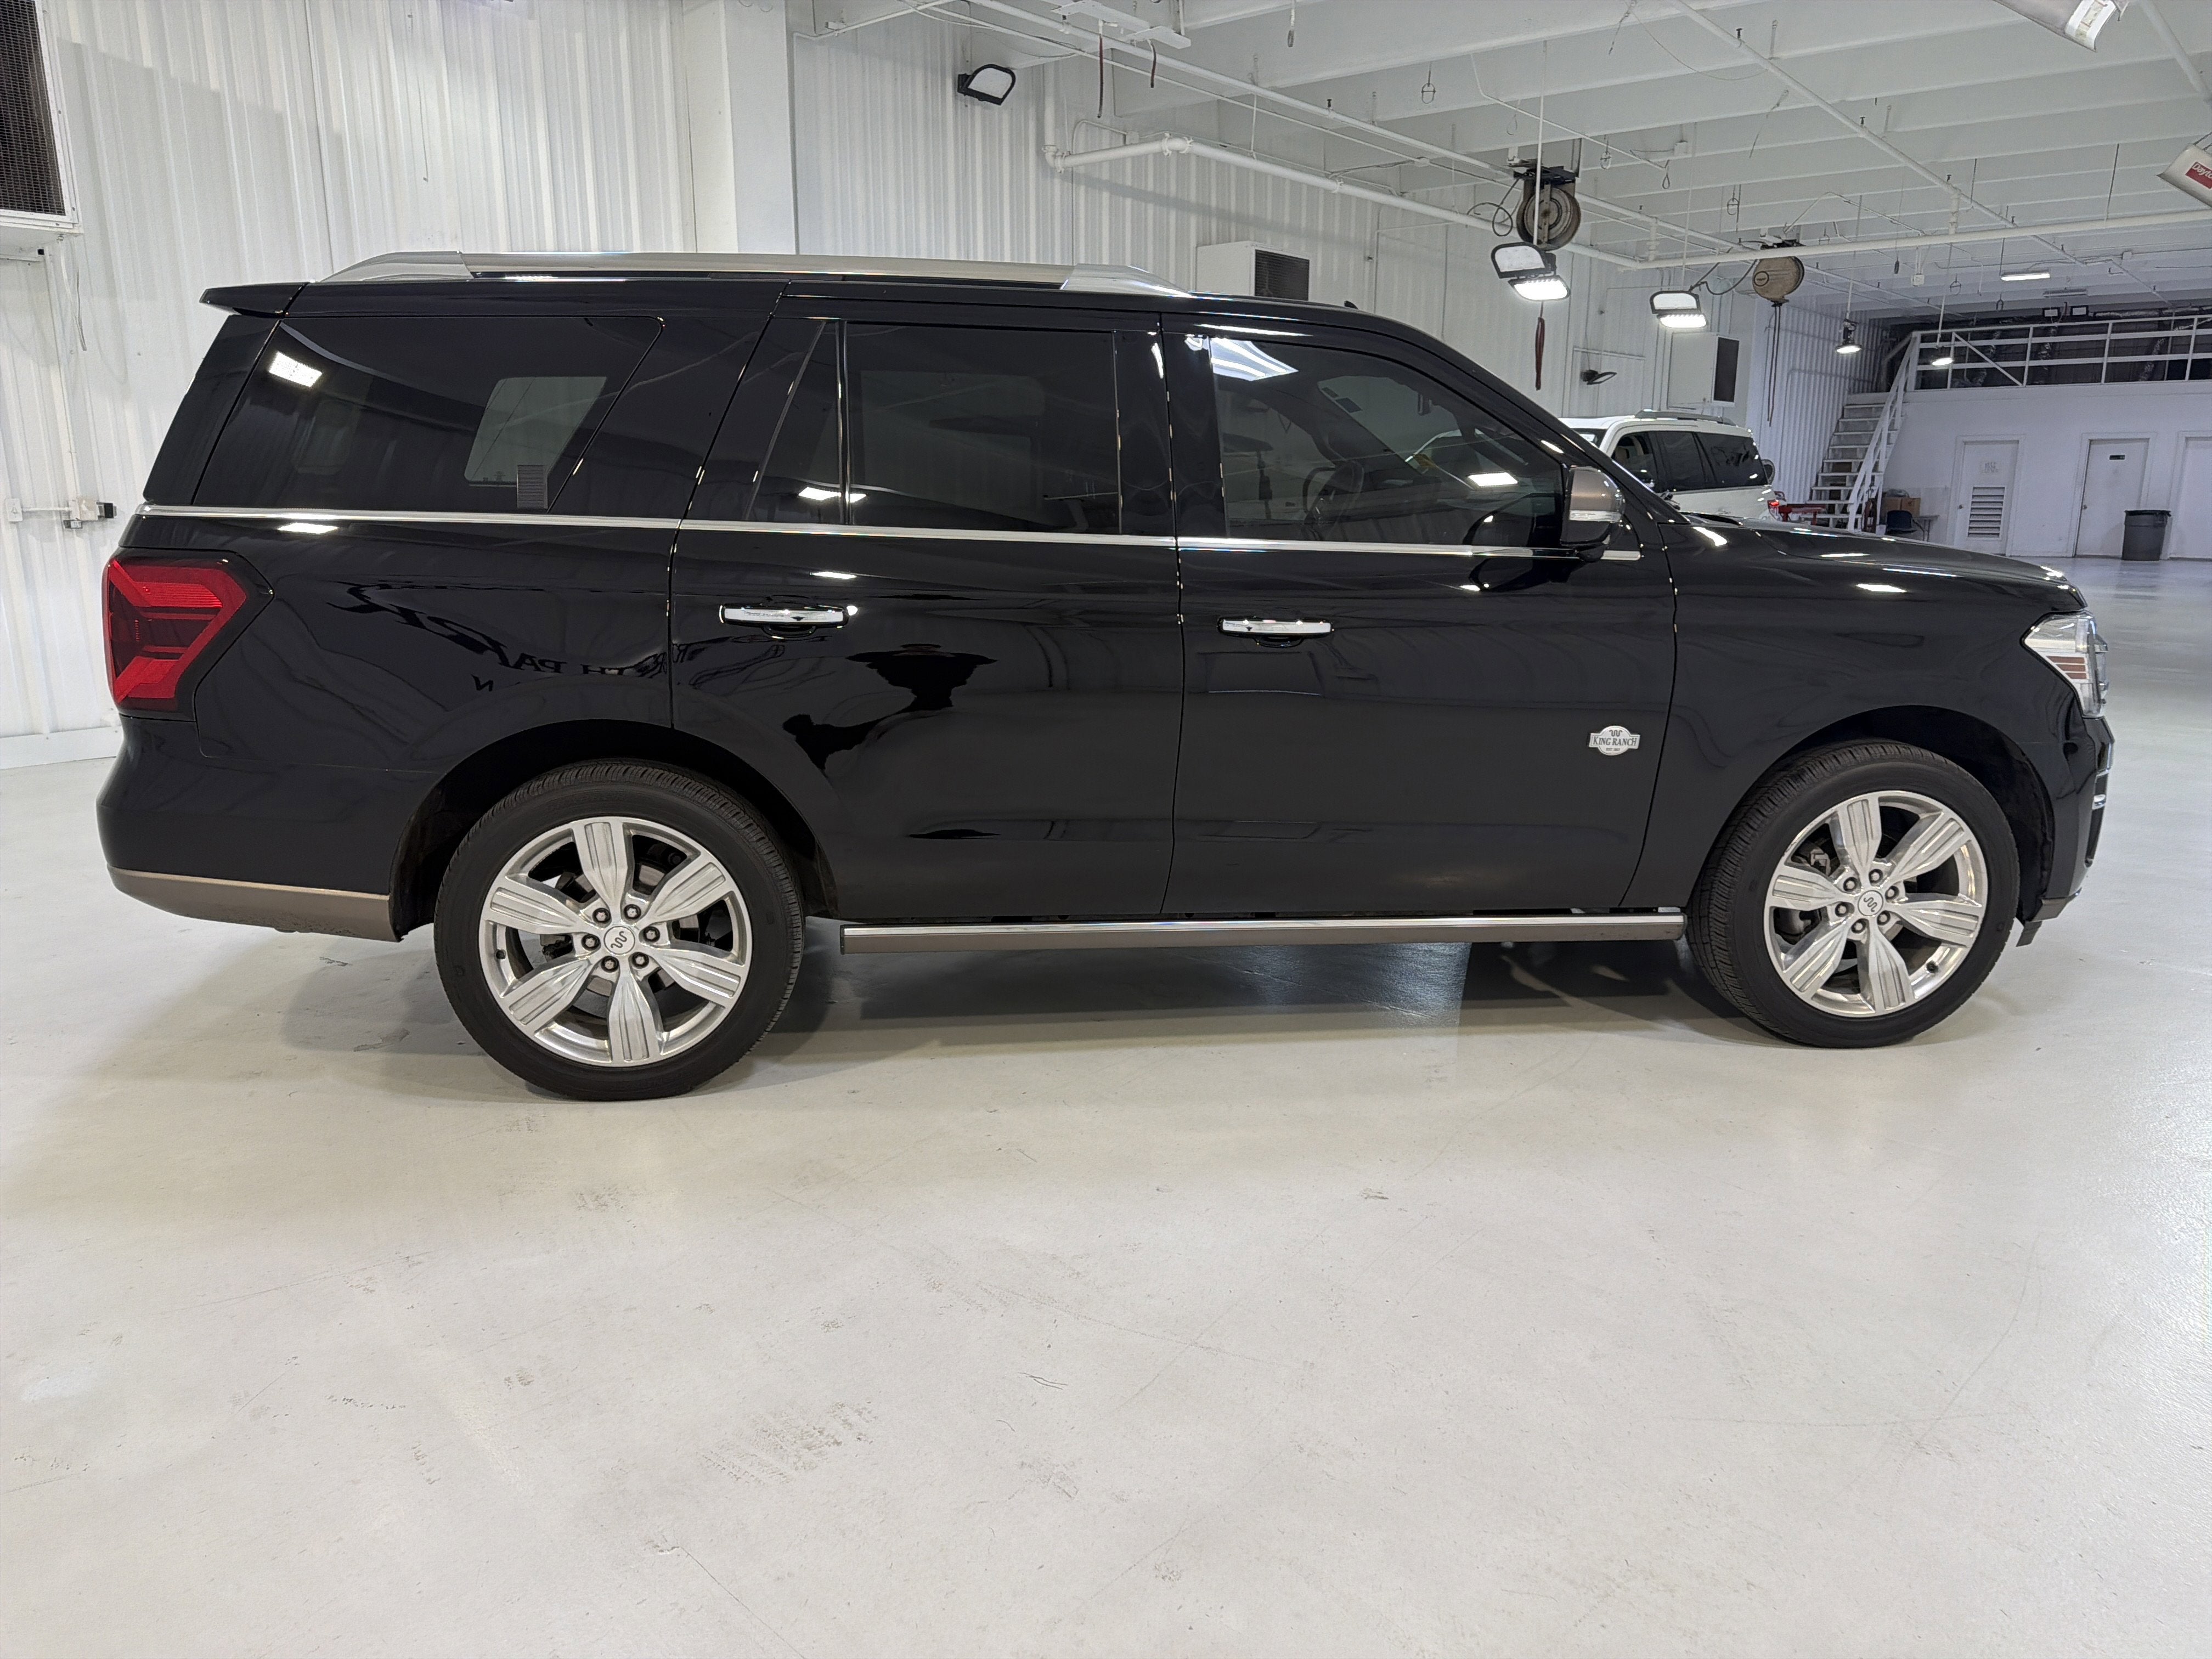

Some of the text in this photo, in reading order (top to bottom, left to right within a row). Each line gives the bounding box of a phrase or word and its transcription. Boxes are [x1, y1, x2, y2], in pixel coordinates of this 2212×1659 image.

[2192, 163, 2212, 180] Dayto
[1593, 736, 1637, 746] KING RANCH
